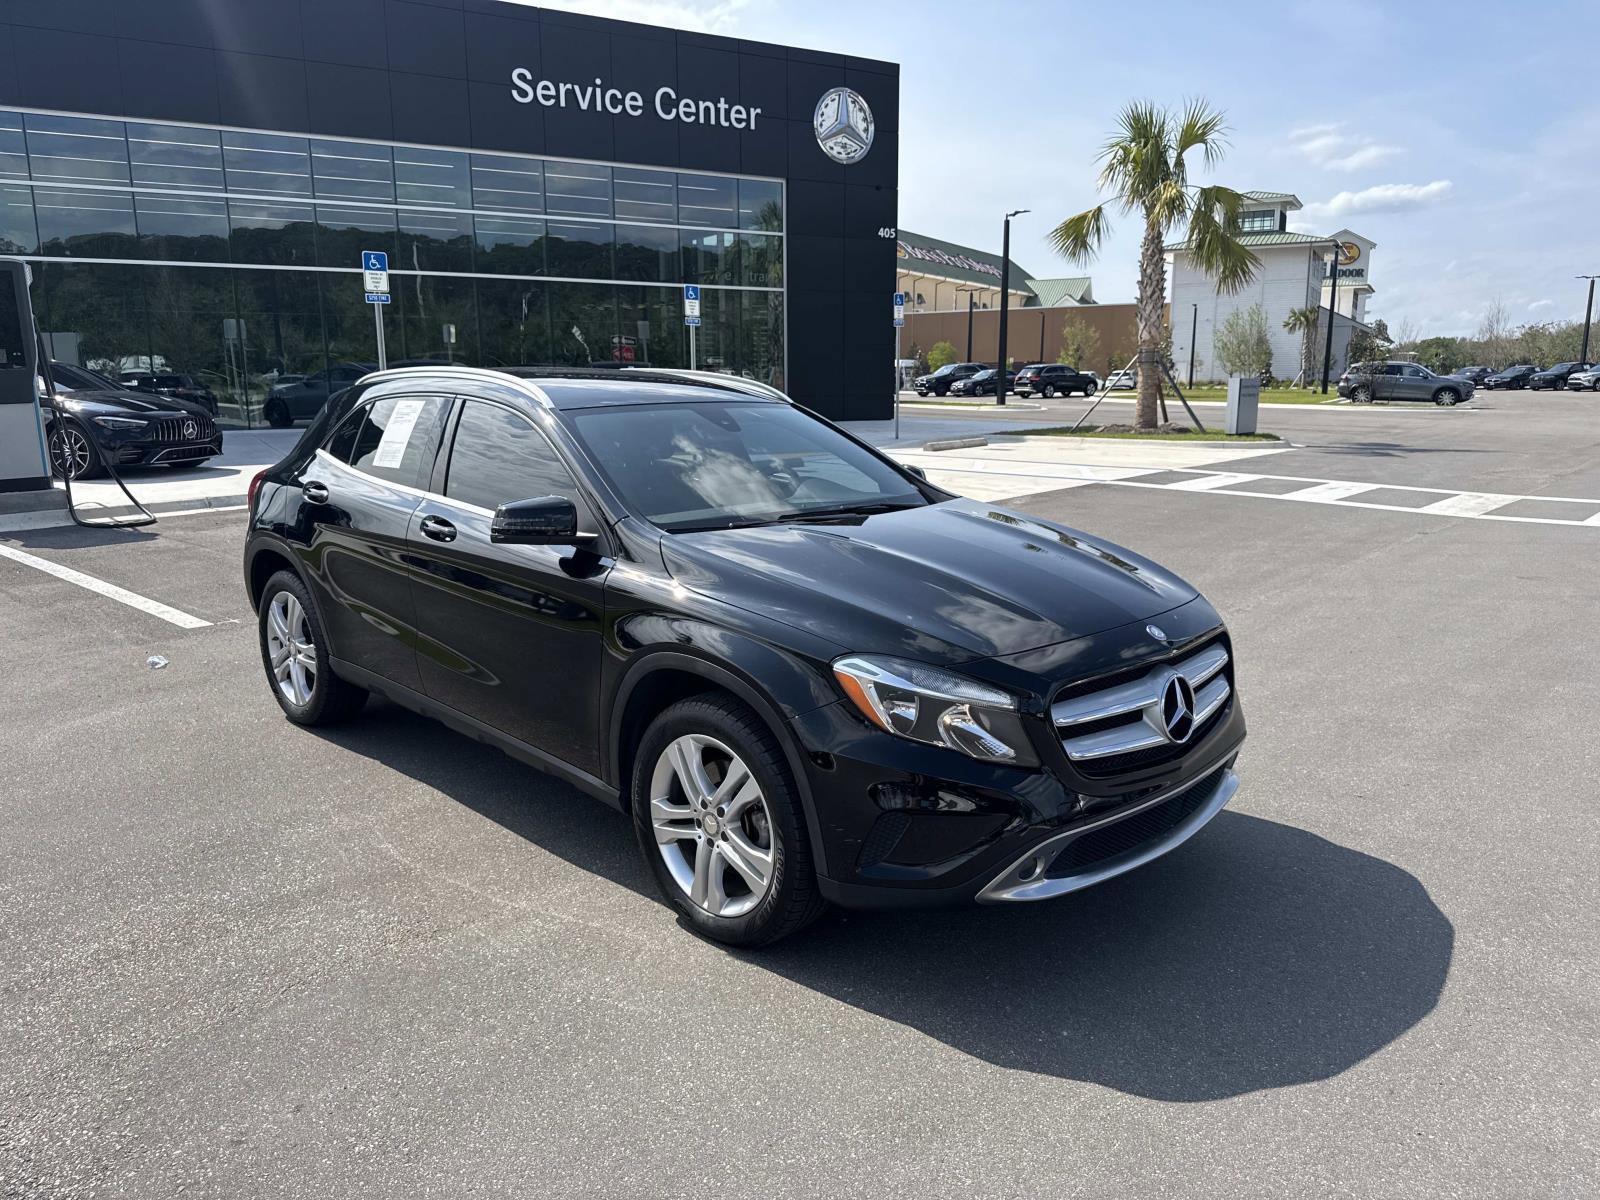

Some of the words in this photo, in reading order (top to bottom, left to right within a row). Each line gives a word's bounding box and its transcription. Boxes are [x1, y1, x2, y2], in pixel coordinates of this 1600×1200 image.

[511, 67, 644, 116] Service
[654, 86, 762, 130] Center
[878, 227, 896, 239] 405
